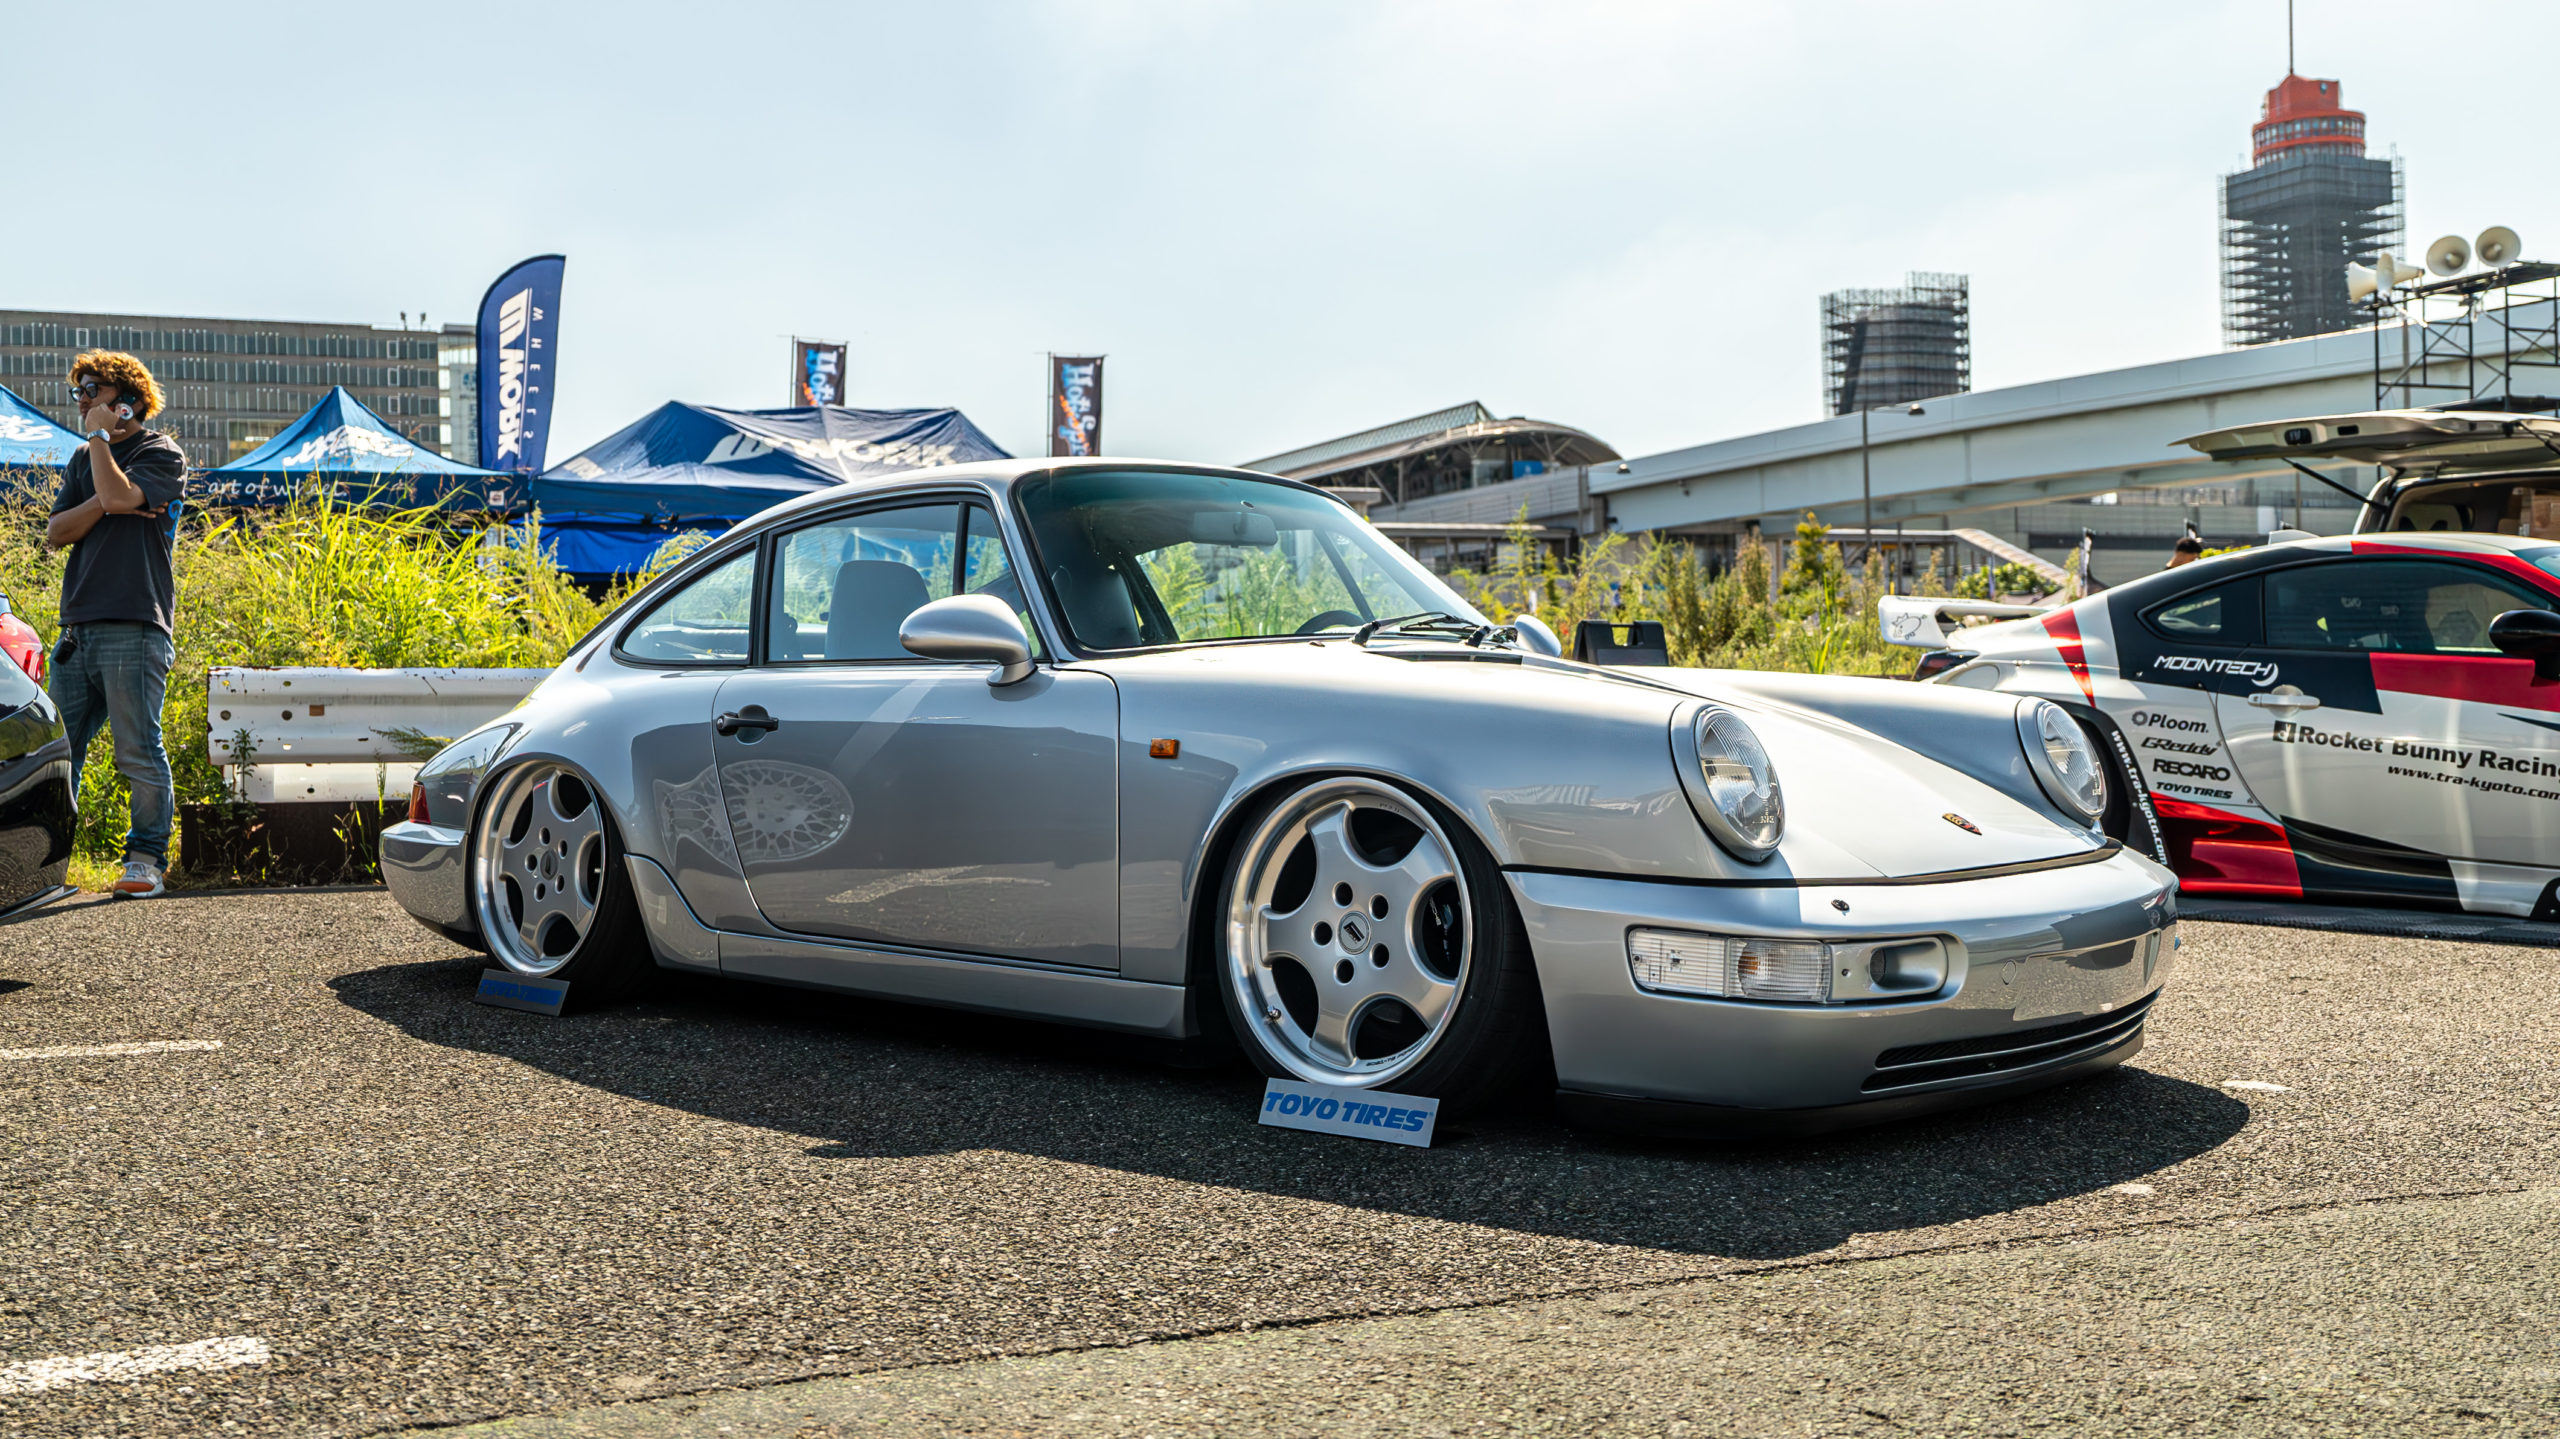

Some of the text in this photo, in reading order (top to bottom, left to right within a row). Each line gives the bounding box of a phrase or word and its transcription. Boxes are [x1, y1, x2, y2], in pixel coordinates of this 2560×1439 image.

[245, 478, 270, 498] of
[2154, 655, 2274, 677] MOONTECH
[2298, 725, 2560, 785] Rocket Bunny Racin
[2152, 758, 2231, 782] RECARO
[2156, 782, 2233, 799] TOYO TIRES
[1265, 1092, 1428, 1132] TOYO TIRES
